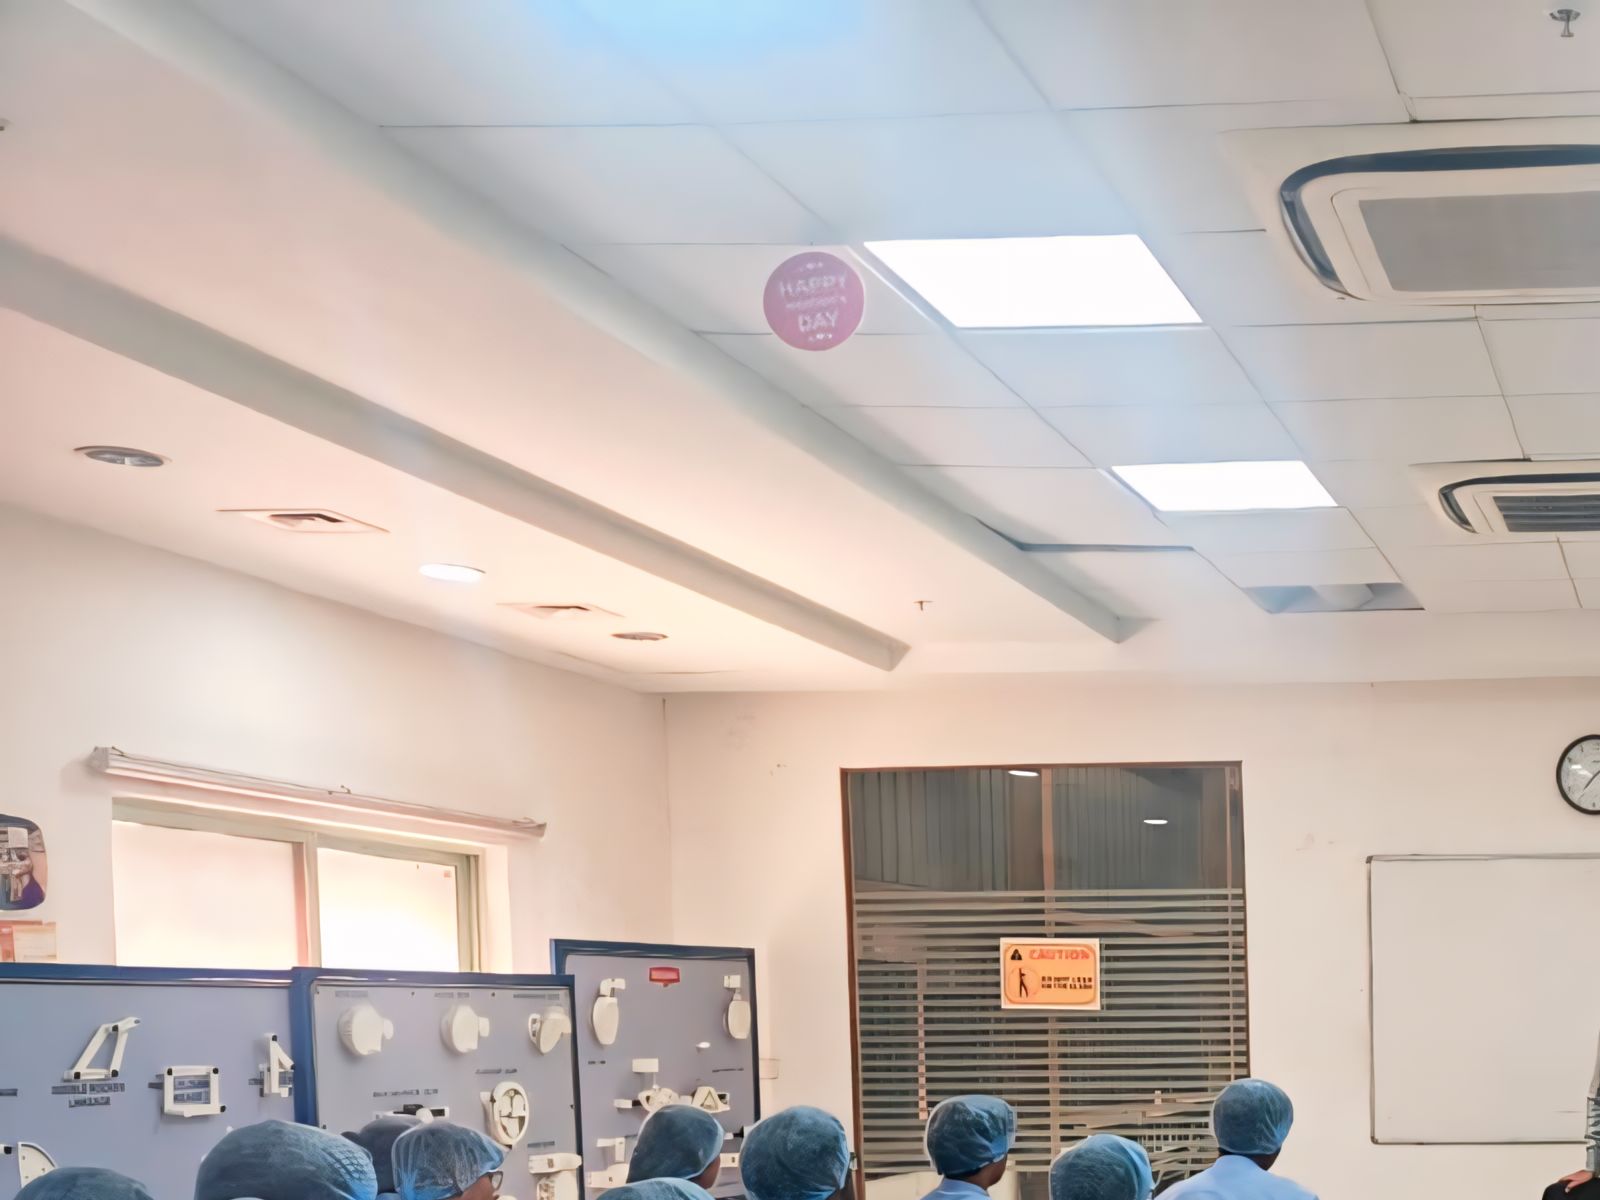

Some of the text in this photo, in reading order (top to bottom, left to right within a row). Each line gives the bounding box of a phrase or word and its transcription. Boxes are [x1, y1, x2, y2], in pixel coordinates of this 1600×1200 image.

[778, 273, 847, 297] HAPPY
[798, 309, 838, 333] DAY
[1029, 949, 1090, 960] CAUTION
